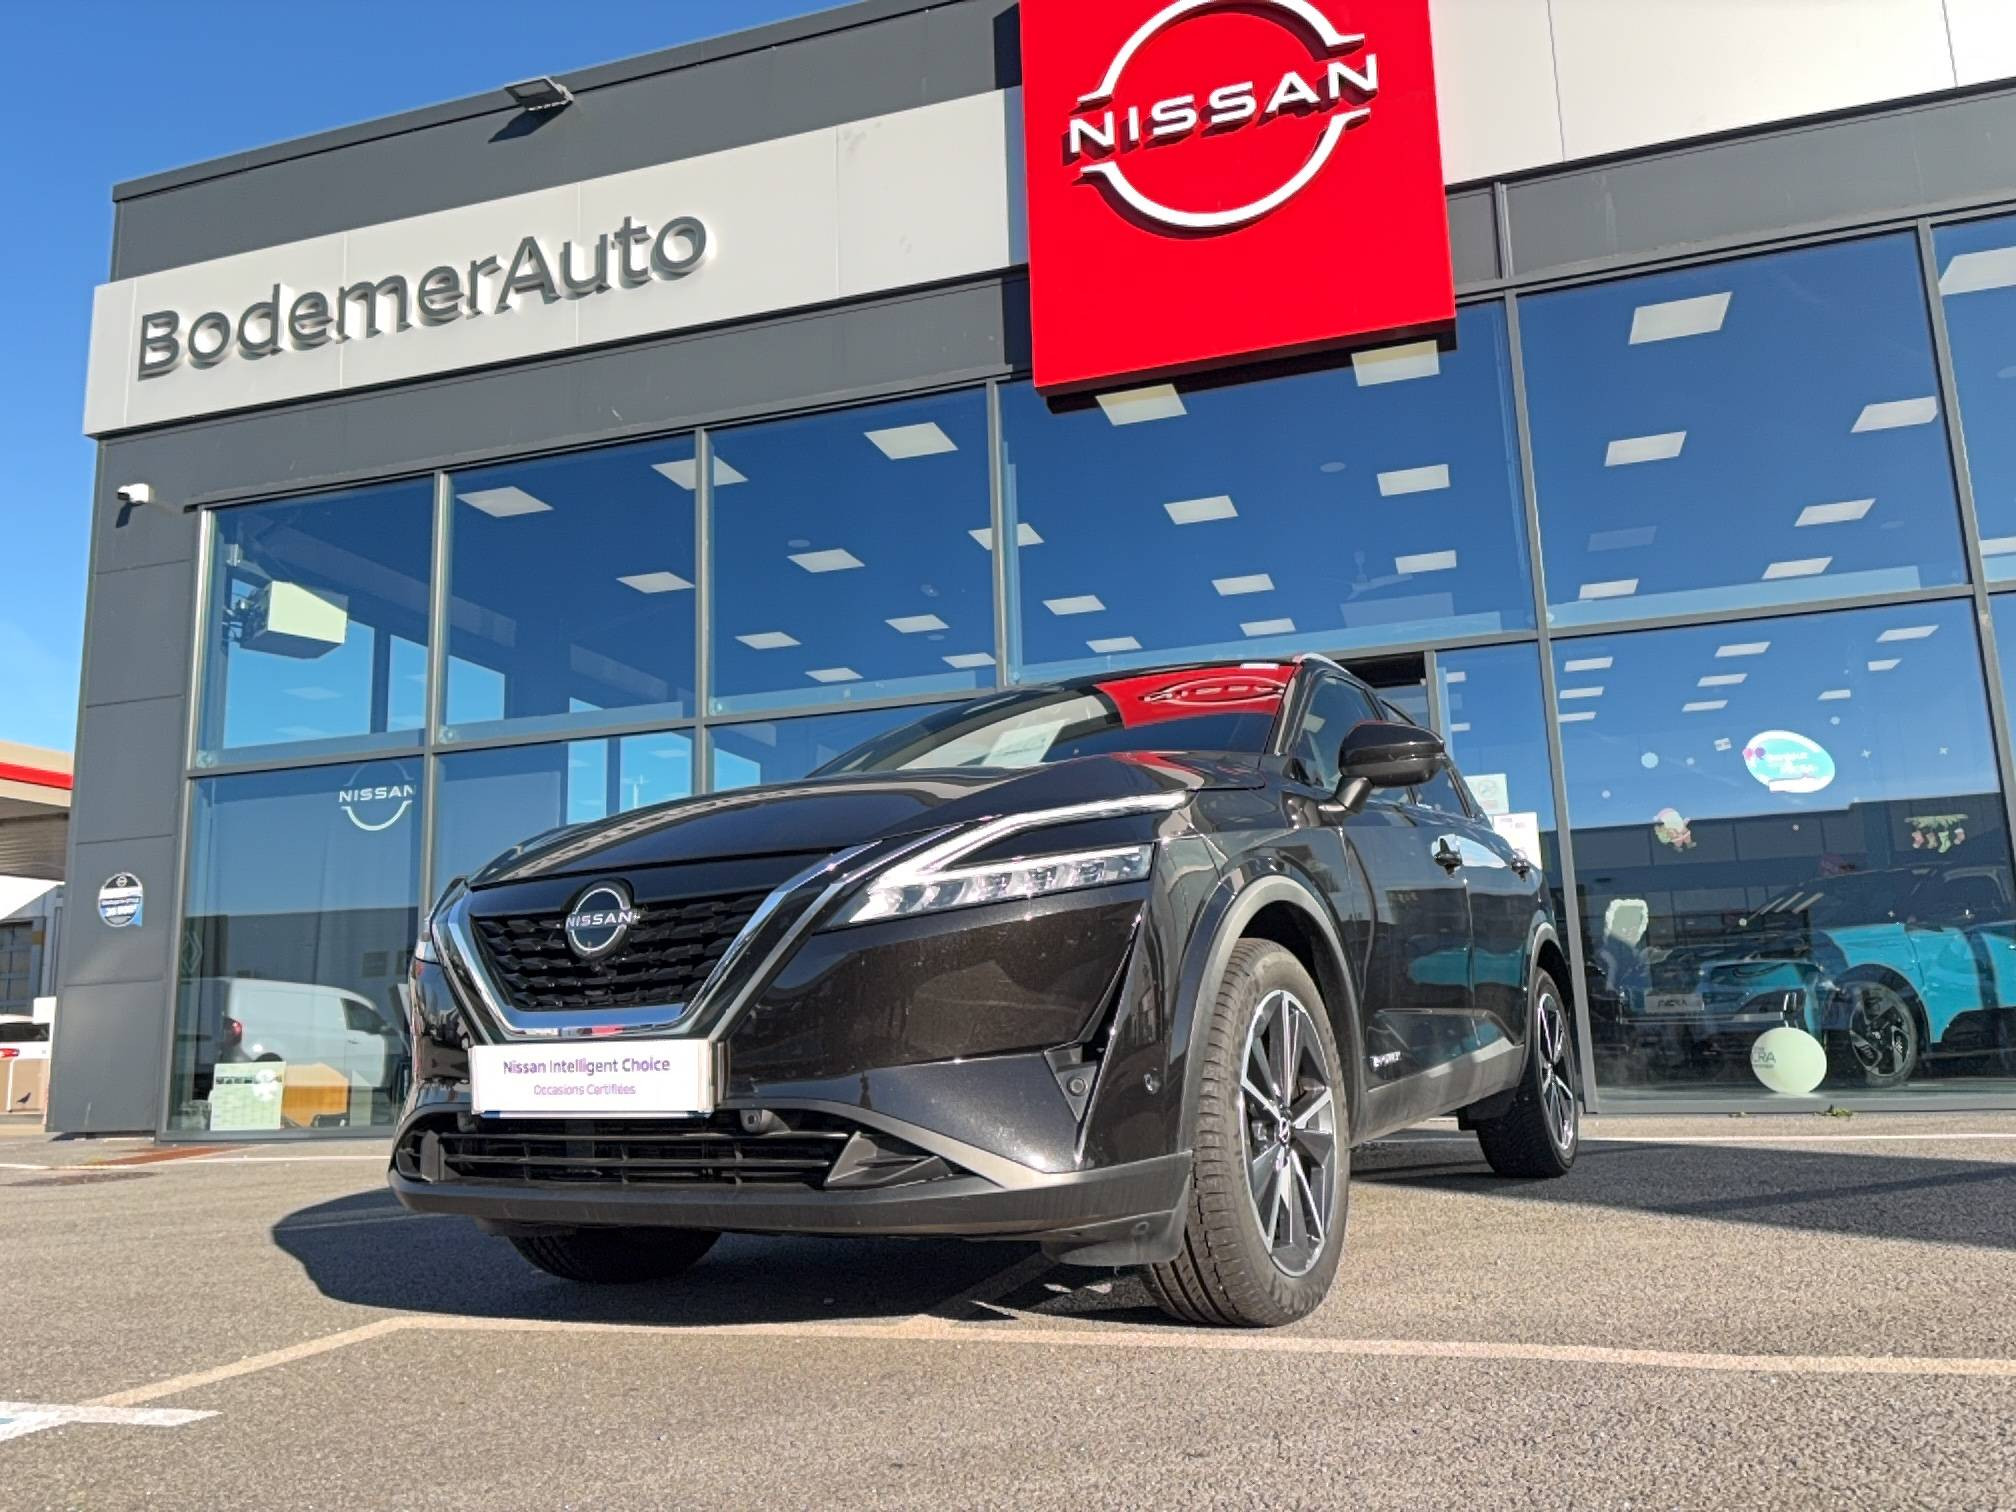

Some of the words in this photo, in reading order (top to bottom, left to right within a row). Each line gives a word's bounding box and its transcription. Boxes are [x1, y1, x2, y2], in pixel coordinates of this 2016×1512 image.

[1069, 53, 1378, 153] NISSAN
[137, 215, 708, 381] BodemerAuto
[338, 784, 417, 803] NISSAN
[566, 911, 632, 928] NISSAN
[503, 1060, 547, 1075] Nissan
[549, 1058, 618, 1076] Intelligent
[622, 1057, 671, 1073] Choice
[533, 1084, 585, 1096] Occasions
